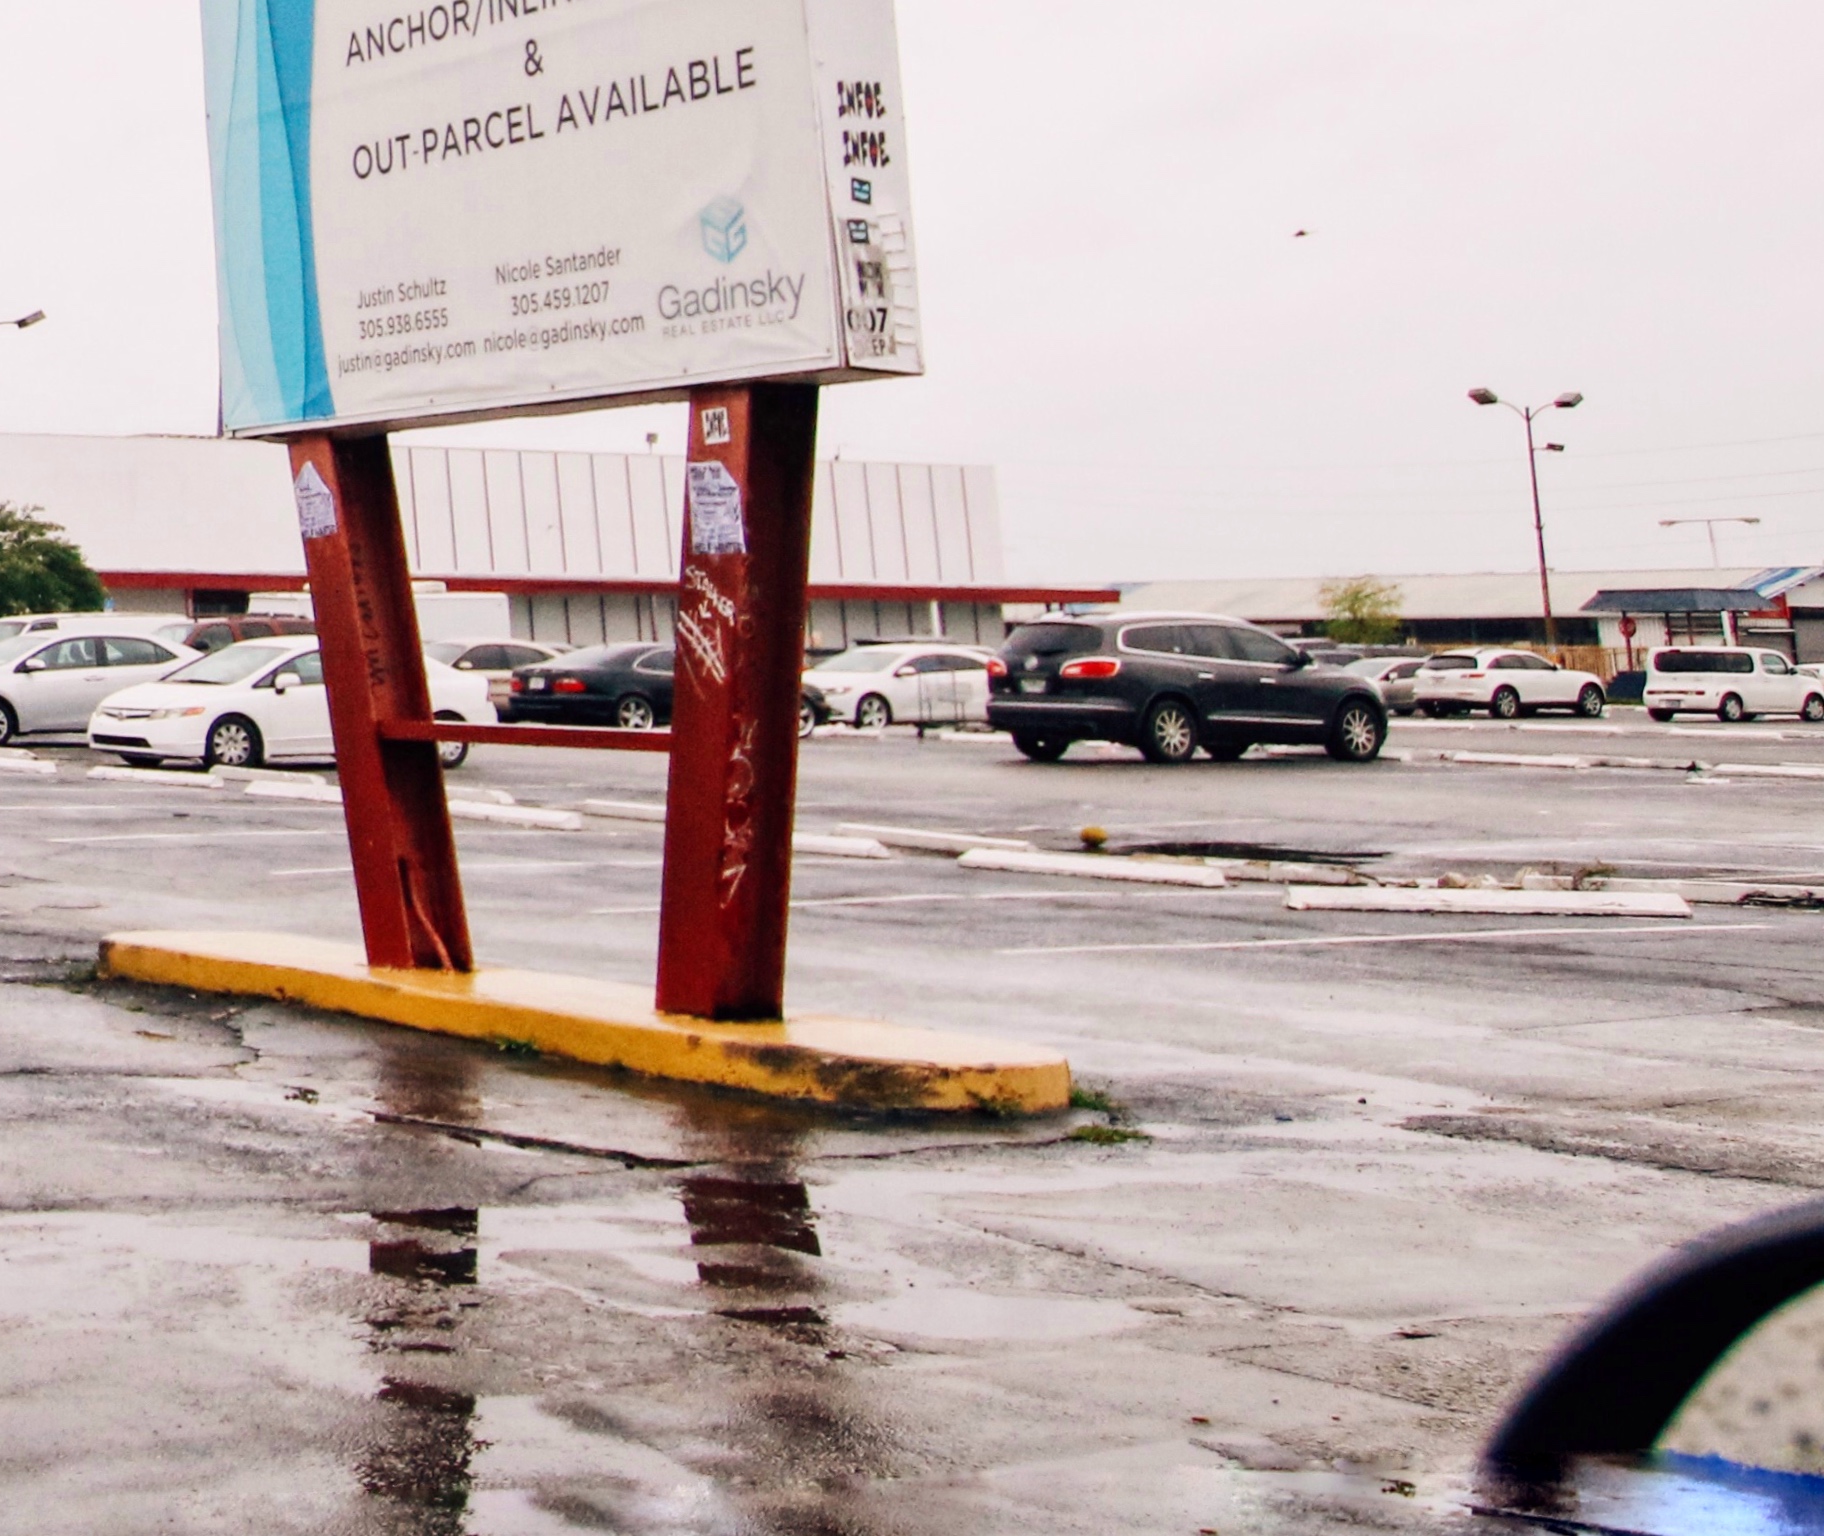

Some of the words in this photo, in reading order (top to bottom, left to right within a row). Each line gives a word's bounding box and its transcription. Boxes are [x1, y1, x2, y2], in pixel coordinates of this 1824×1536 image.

[524, 39, 544, 77] &
[353, 103, 545, 179] OUT-PARCEL
[556, 46, 757, 133] AVAILABLE
[495, 261, 541, 286] Nicole
[545, 246, 622, 278] Santander
[356, 285, 395, 311] Justin
[398, 278, 447, 303] Schultz
[510, 281, 610, 316] 305.459.1207
[657, 268, 806, 322] Gadinsky
[358, 310, 449, 340] 305.938.6555
[483, 313, 645, 352] nicole@gadinsky.com
[662, 321, 696, 338] REAL
[700, 314, 753, 335] ESTATE
[338, 340, 476, 376] justin@gadinsky.com
